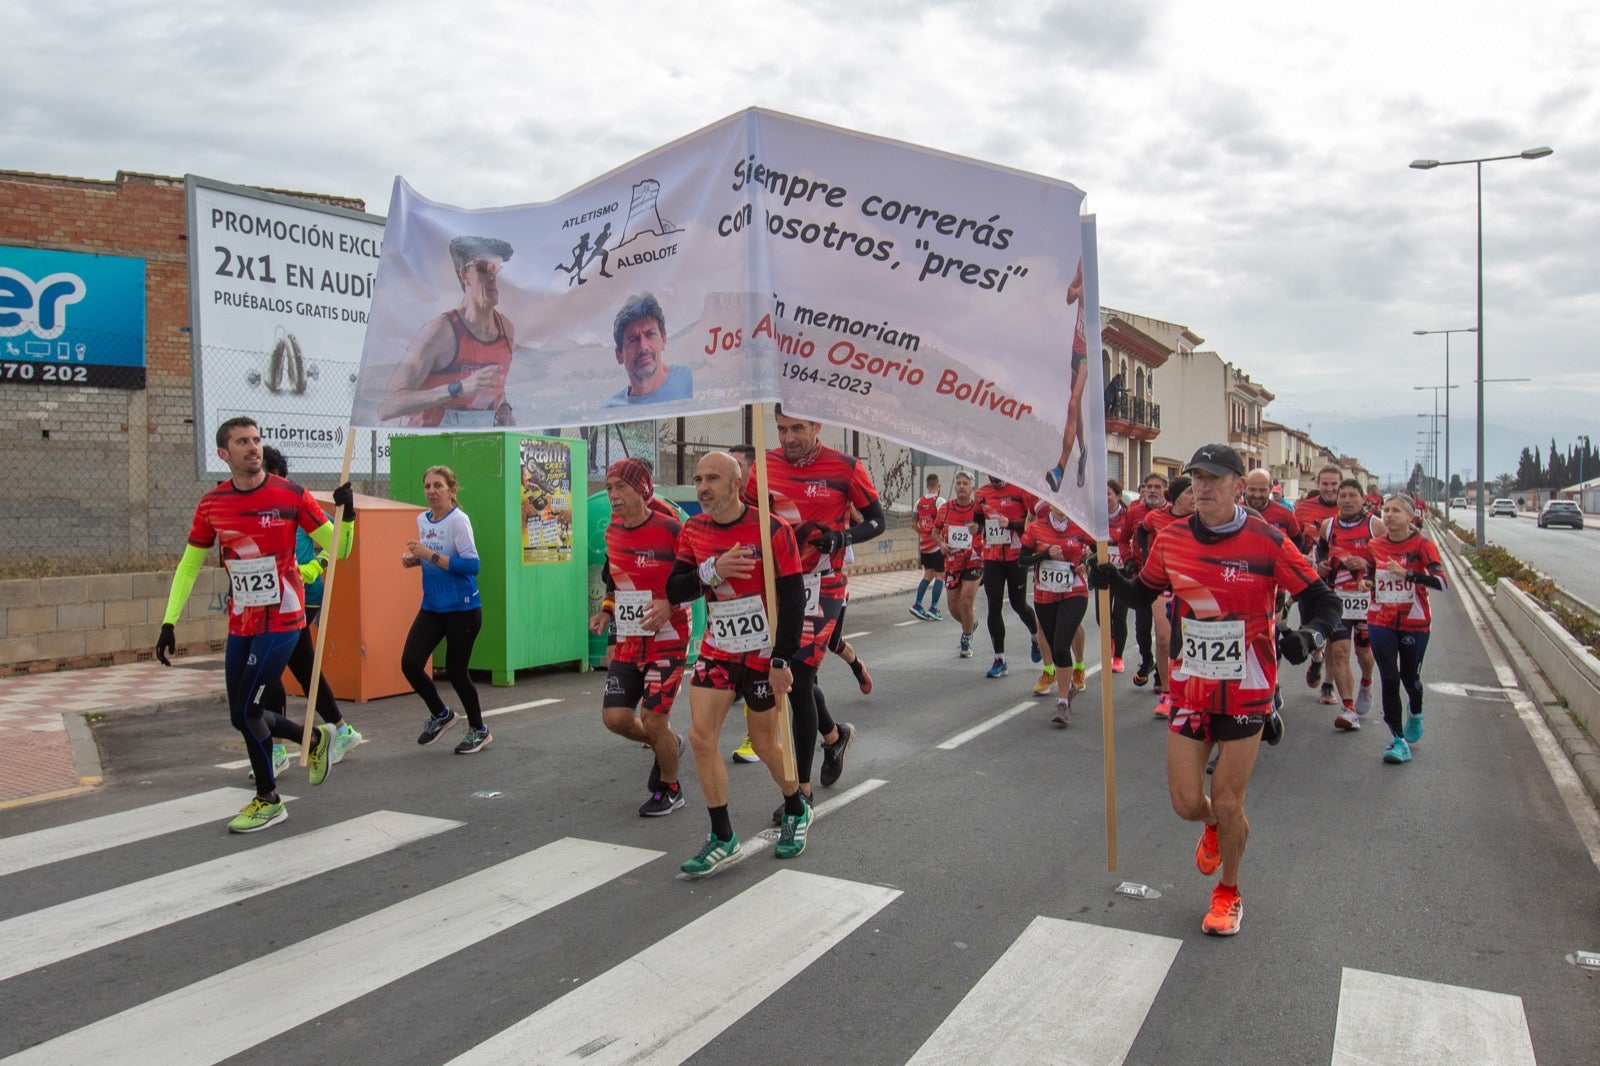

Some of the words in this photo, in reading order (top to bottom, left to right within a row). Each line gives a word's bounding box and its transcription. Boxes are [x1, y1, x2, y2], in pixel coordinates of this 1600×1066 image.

[562, 201, 619, 230] ATLETISMO
[861, 195, 1014, 250] correrás
[211, 208, 335, 250] PROMOCIÓN
[339, 233, 383, 258] EXCL
[617, 244, 677, 269] ALBOLOTE
[286, 263, 314, 290] EN
[321, 269, 377, 299] AUDÍ
[214, 290, 293, 314] PRUÉBALOS
[296, 302, 339, 320] GRATIS
[773, 293, 785, 318] n
[794, 305, 921, 351] memoriam
[0, 363, 34, 379] 70
[42, 365, 88, 381] 202
[704, 326, 743, 355] Jos
[828, 341, 924, 386] Osorio
[936, 368, 1034, 421] Bolívar
[782, 362, 872, 396] 1964-2023
[951, 532, 969, 542] 622
[988, 527, 1005, 537] 217
[233, 573, 275, 592] 3123
[1041, 570, 1071, 585] 3101
[1378, 580, 1413, 592] 2150
[619, 604, 645, 621] 254
[1342, 599, 1369, 610] 029
[715, 614, 765, 637] 3120
[1186, 637, 1242, 662] 3124
